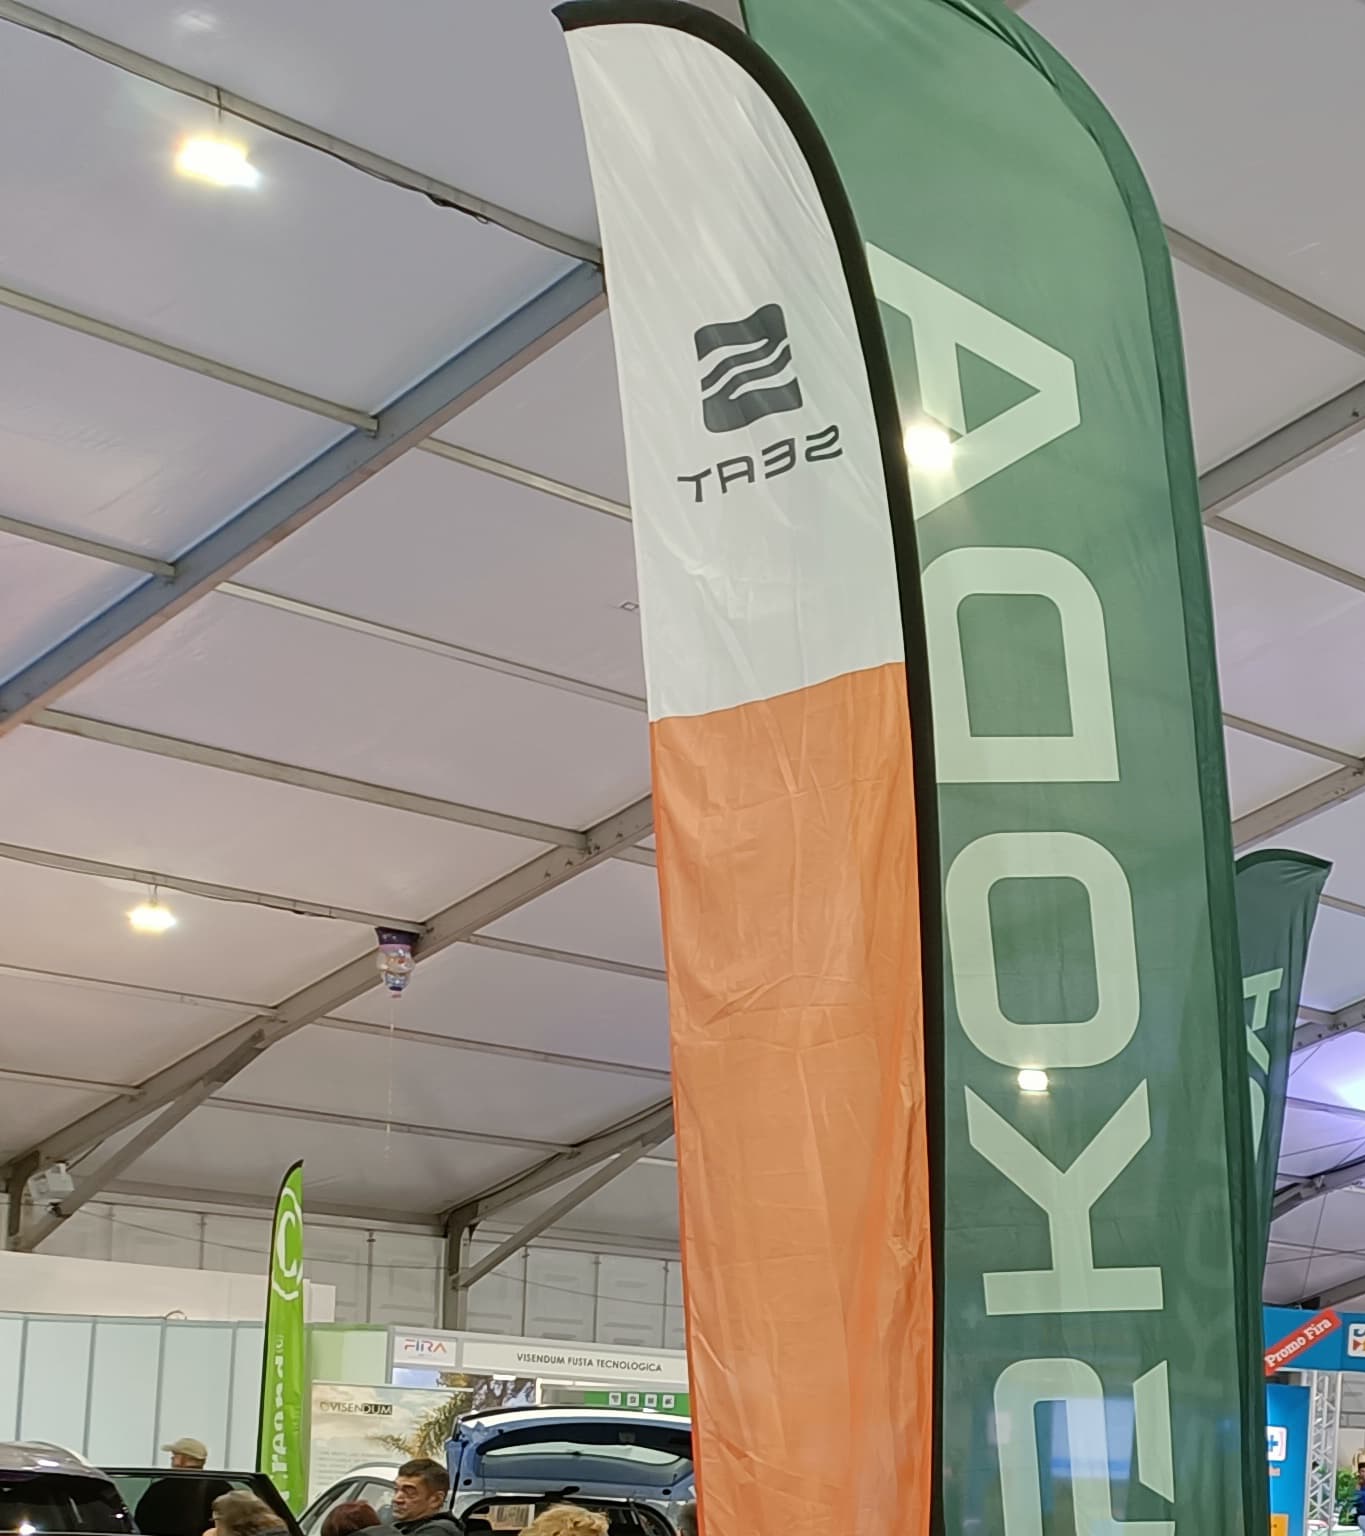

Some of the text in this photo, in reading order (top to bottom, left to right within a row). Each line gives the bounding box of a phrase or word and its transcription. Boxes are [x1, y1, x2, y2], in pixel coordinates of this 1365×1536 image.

[403, 1338, 448, 1353] FIRA
[1264, 1317, 1333, 1368] Promo Fira
[516, 1352, 663, 1373] VISENDUM FUSTA TECNOLOGICA
[330, 1401, 393, 1416] VISENDUM
